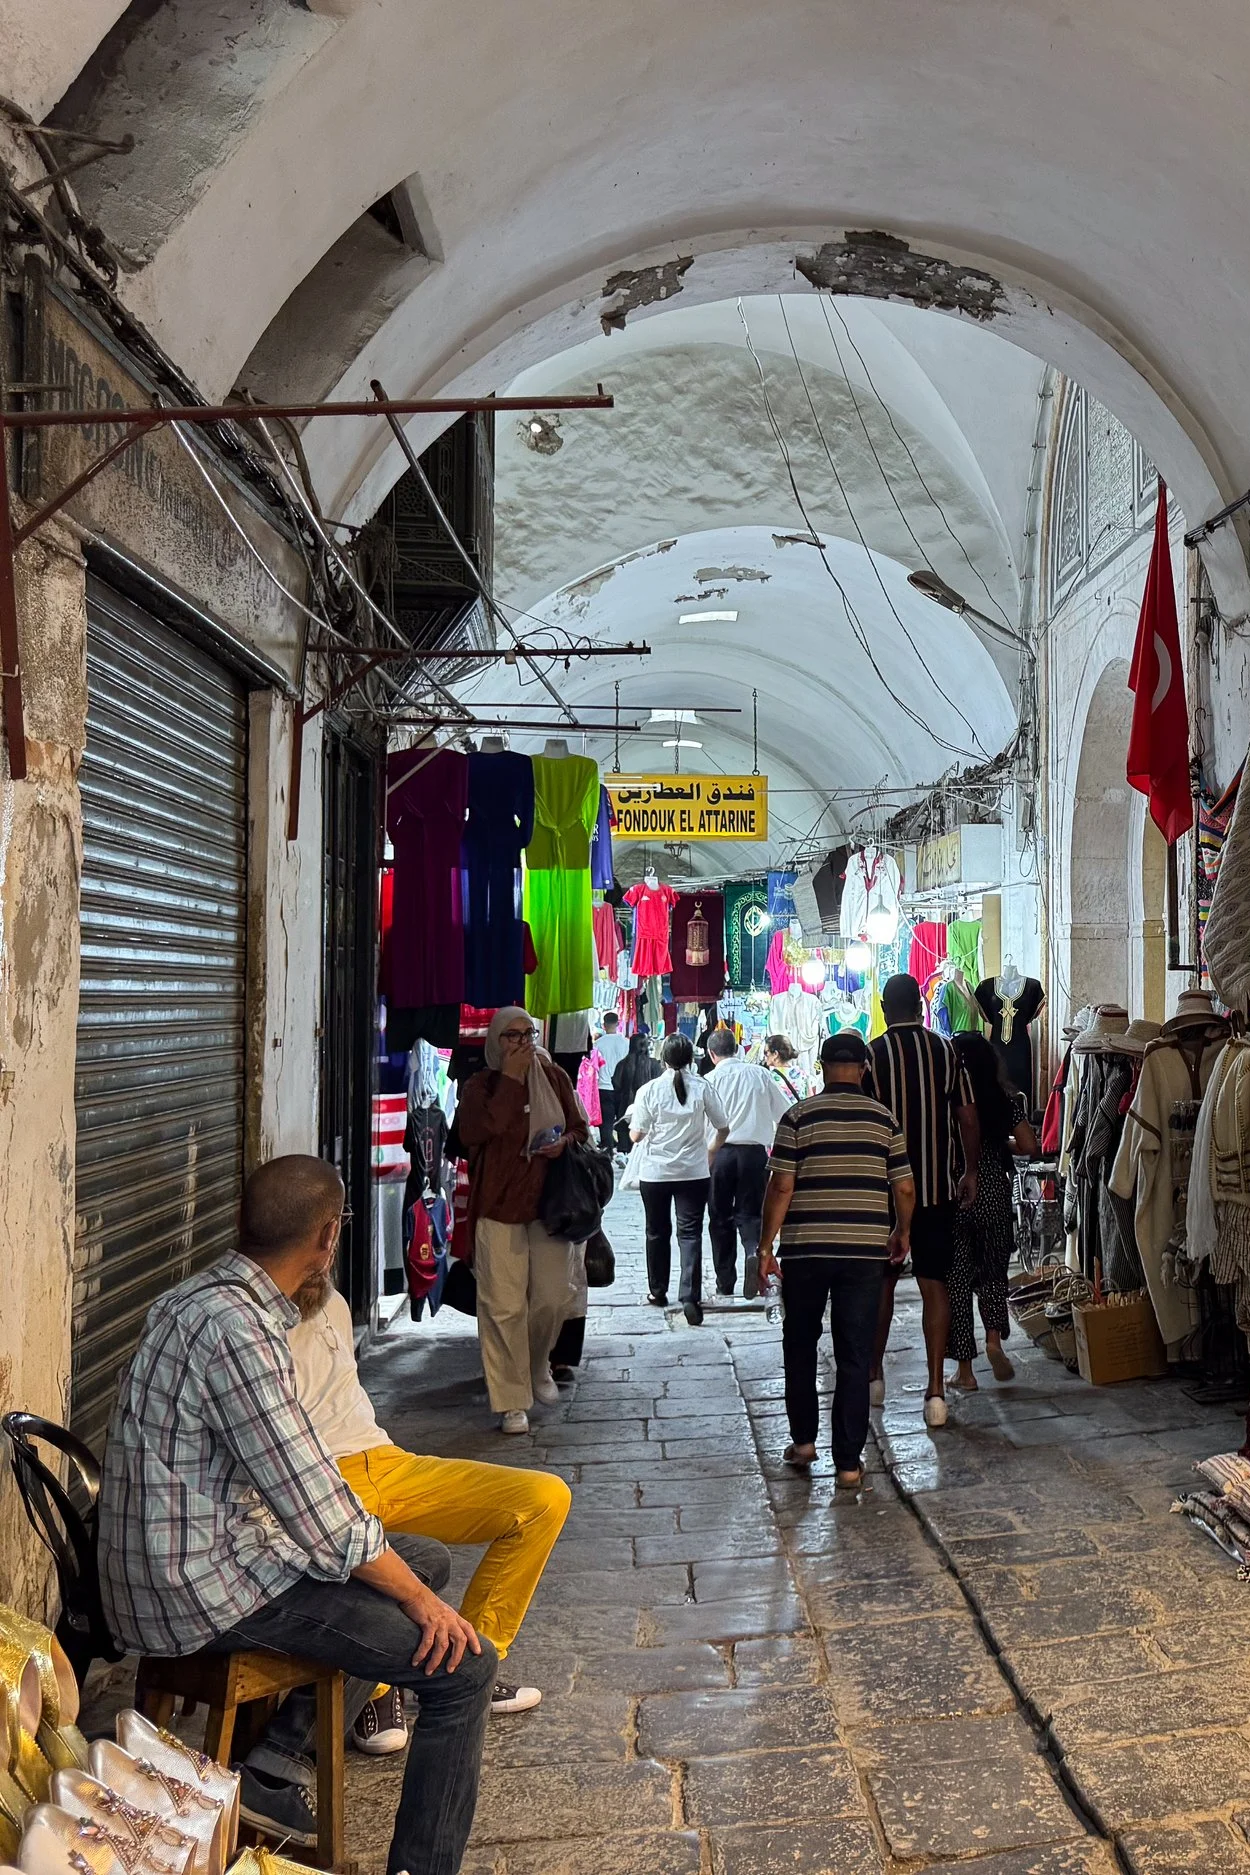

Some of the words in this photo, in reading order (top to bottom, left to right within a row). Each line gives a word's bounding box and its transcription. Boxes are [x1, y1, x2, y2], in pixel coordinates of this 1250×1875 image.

[707, 783, 755, 805] فندق
[617, 809, 675, 833] FONDOUK
[680, 809, 694, 833] EL
[698, 809, 756, 833] ATTARINE
